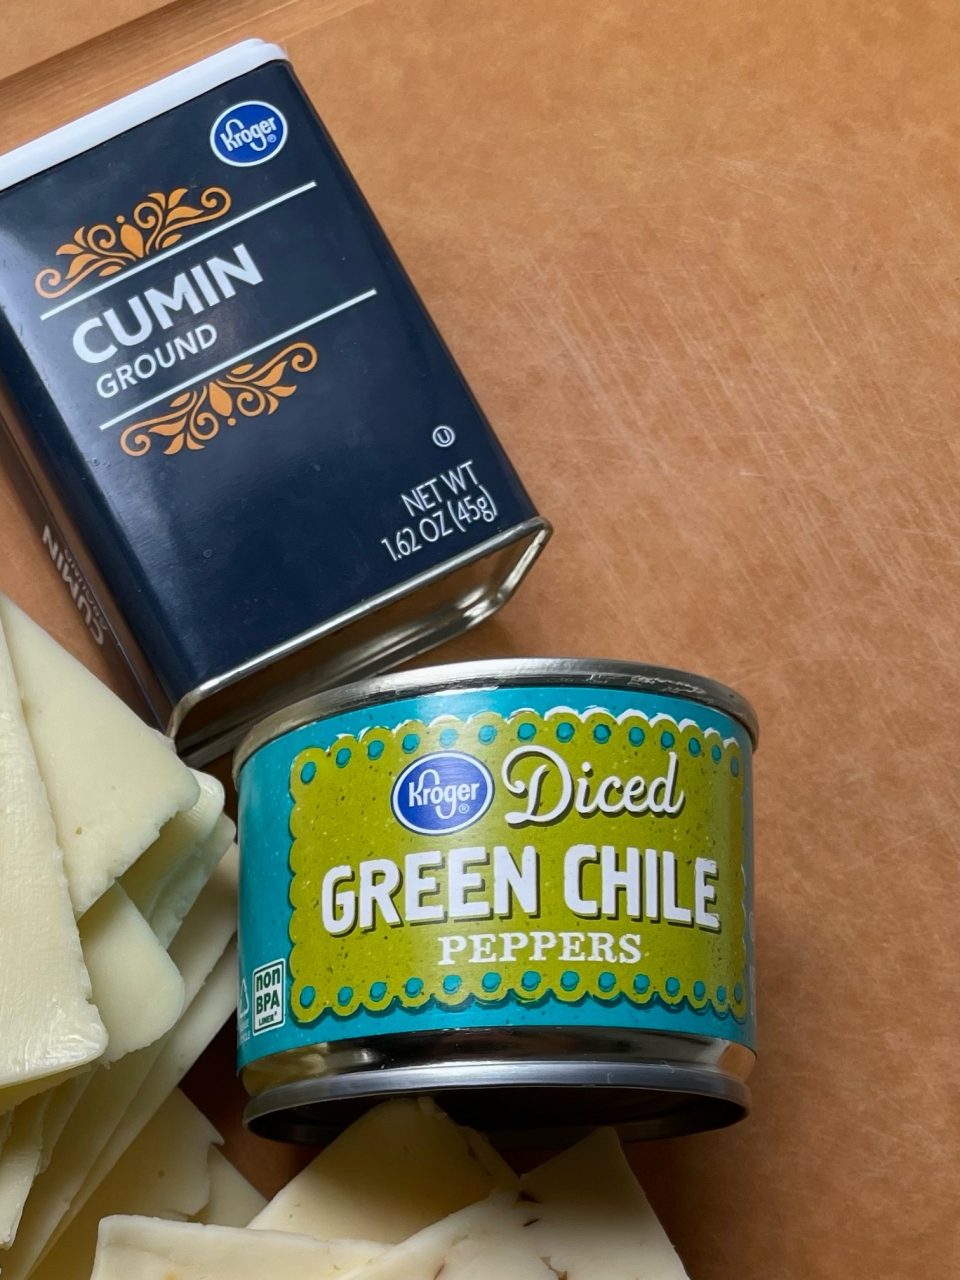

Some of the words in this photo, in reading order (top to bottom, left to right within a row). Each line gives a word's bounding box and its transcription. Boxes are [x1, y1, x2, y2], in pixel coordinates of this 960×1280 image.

[220, 117, 277, 152] Kroger
[73, 243, 264, 364] CUMIN
[96, 324, 218, 399] GROUND
[401, 478, 442, 517] NET
[440, 460, 478, 495] WT
[381, 527, 423, 562] 1.62
[419, 510, 454, 543] OZ
[447, 484, 498, 533] (45g)
[408, 769, 480, 819] Kroger
[502, 745, 685, 824] Diced
[321, 845, 539, 935] GREEN
[563, 843, 722, 930] CHILE
[255, 967, 281, 992] non
[437, 931, 642, 966] PEPPERS
[256, 990, 280, 1015] BPA
